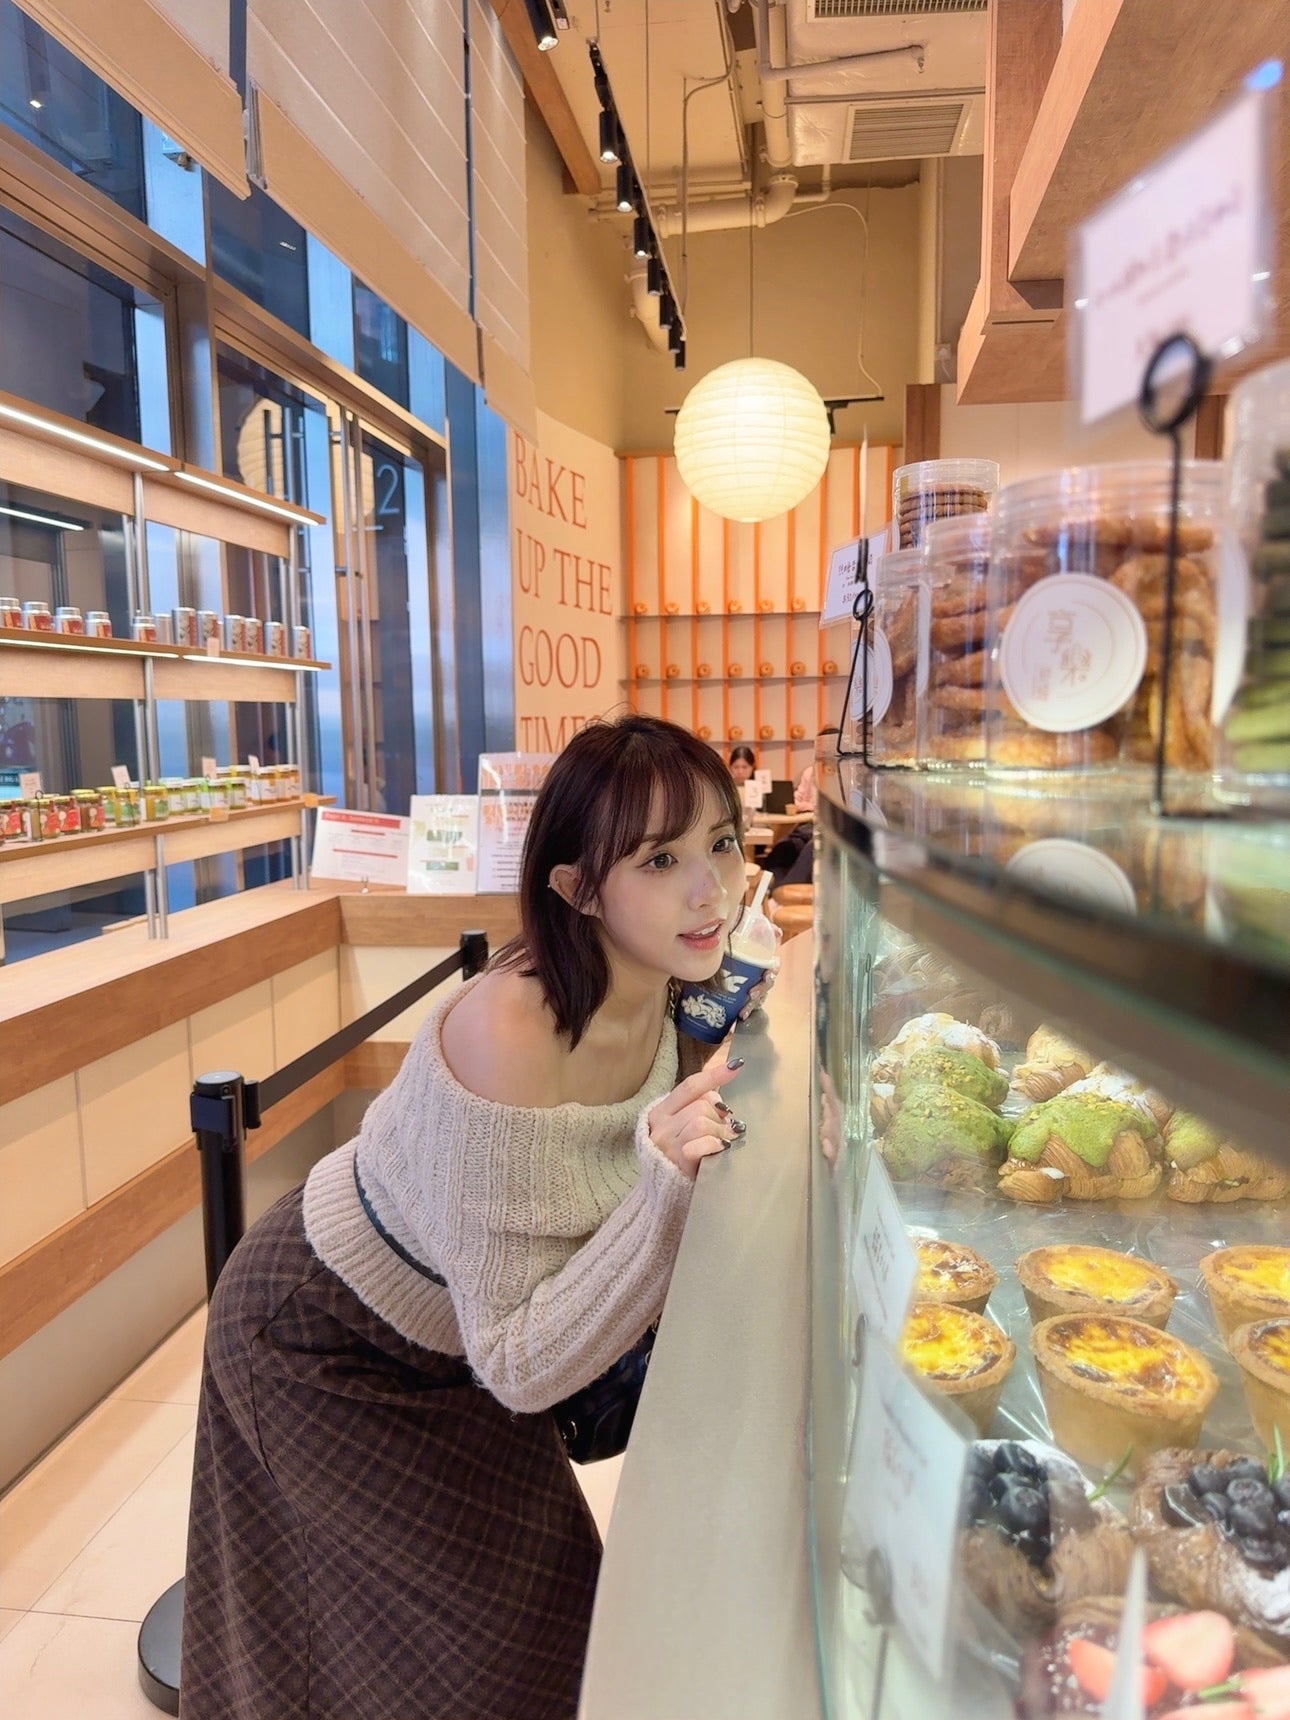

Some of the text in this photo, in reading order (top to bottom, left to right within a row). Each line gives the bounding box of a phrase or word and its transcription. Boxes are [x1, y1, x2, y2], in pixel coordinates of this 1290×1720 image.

[377, 464, 400, 516] 2
[514, 431, 587, 529] BAKE
[516, 528, 613, 616] UP THE
[519, 625, 603, 689] GOOD
[521, 715, 601, 754] TIM
